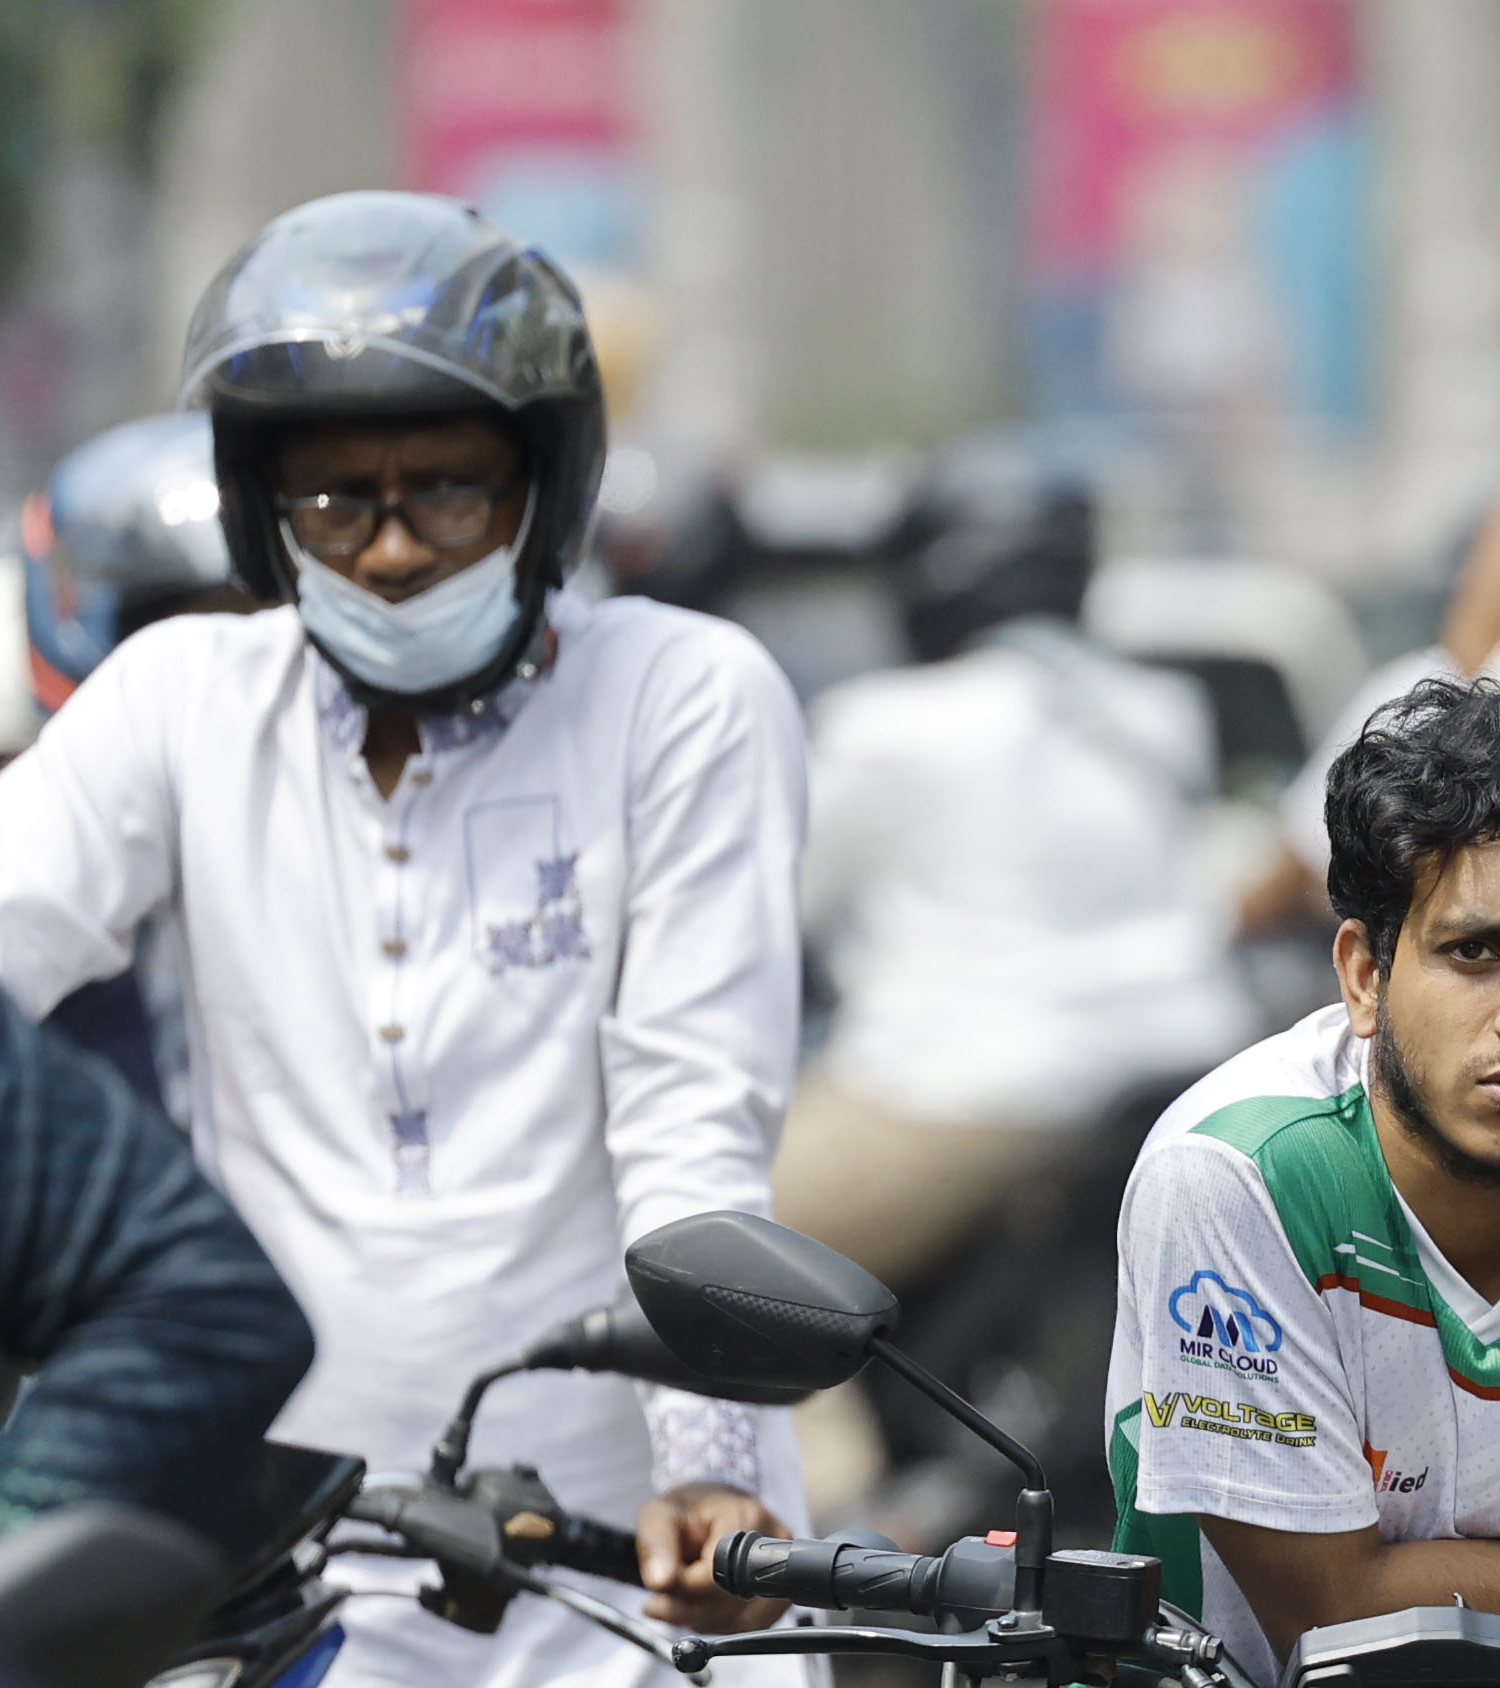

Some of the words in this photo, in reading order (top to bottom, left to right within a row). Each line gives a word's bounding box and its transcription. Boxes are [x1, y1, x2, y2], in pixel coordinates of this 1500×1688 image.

[1180, 1338, 1213, 1359] MIR
[1219, 1348, 1278, 1374] CLOUD
[1180, 1354, 1212, 1368] GLOBAL
[1181, 1416, 1272, 1442] ELECTROLYTE
[1275, 1434, 1317, 1448] DRINK
